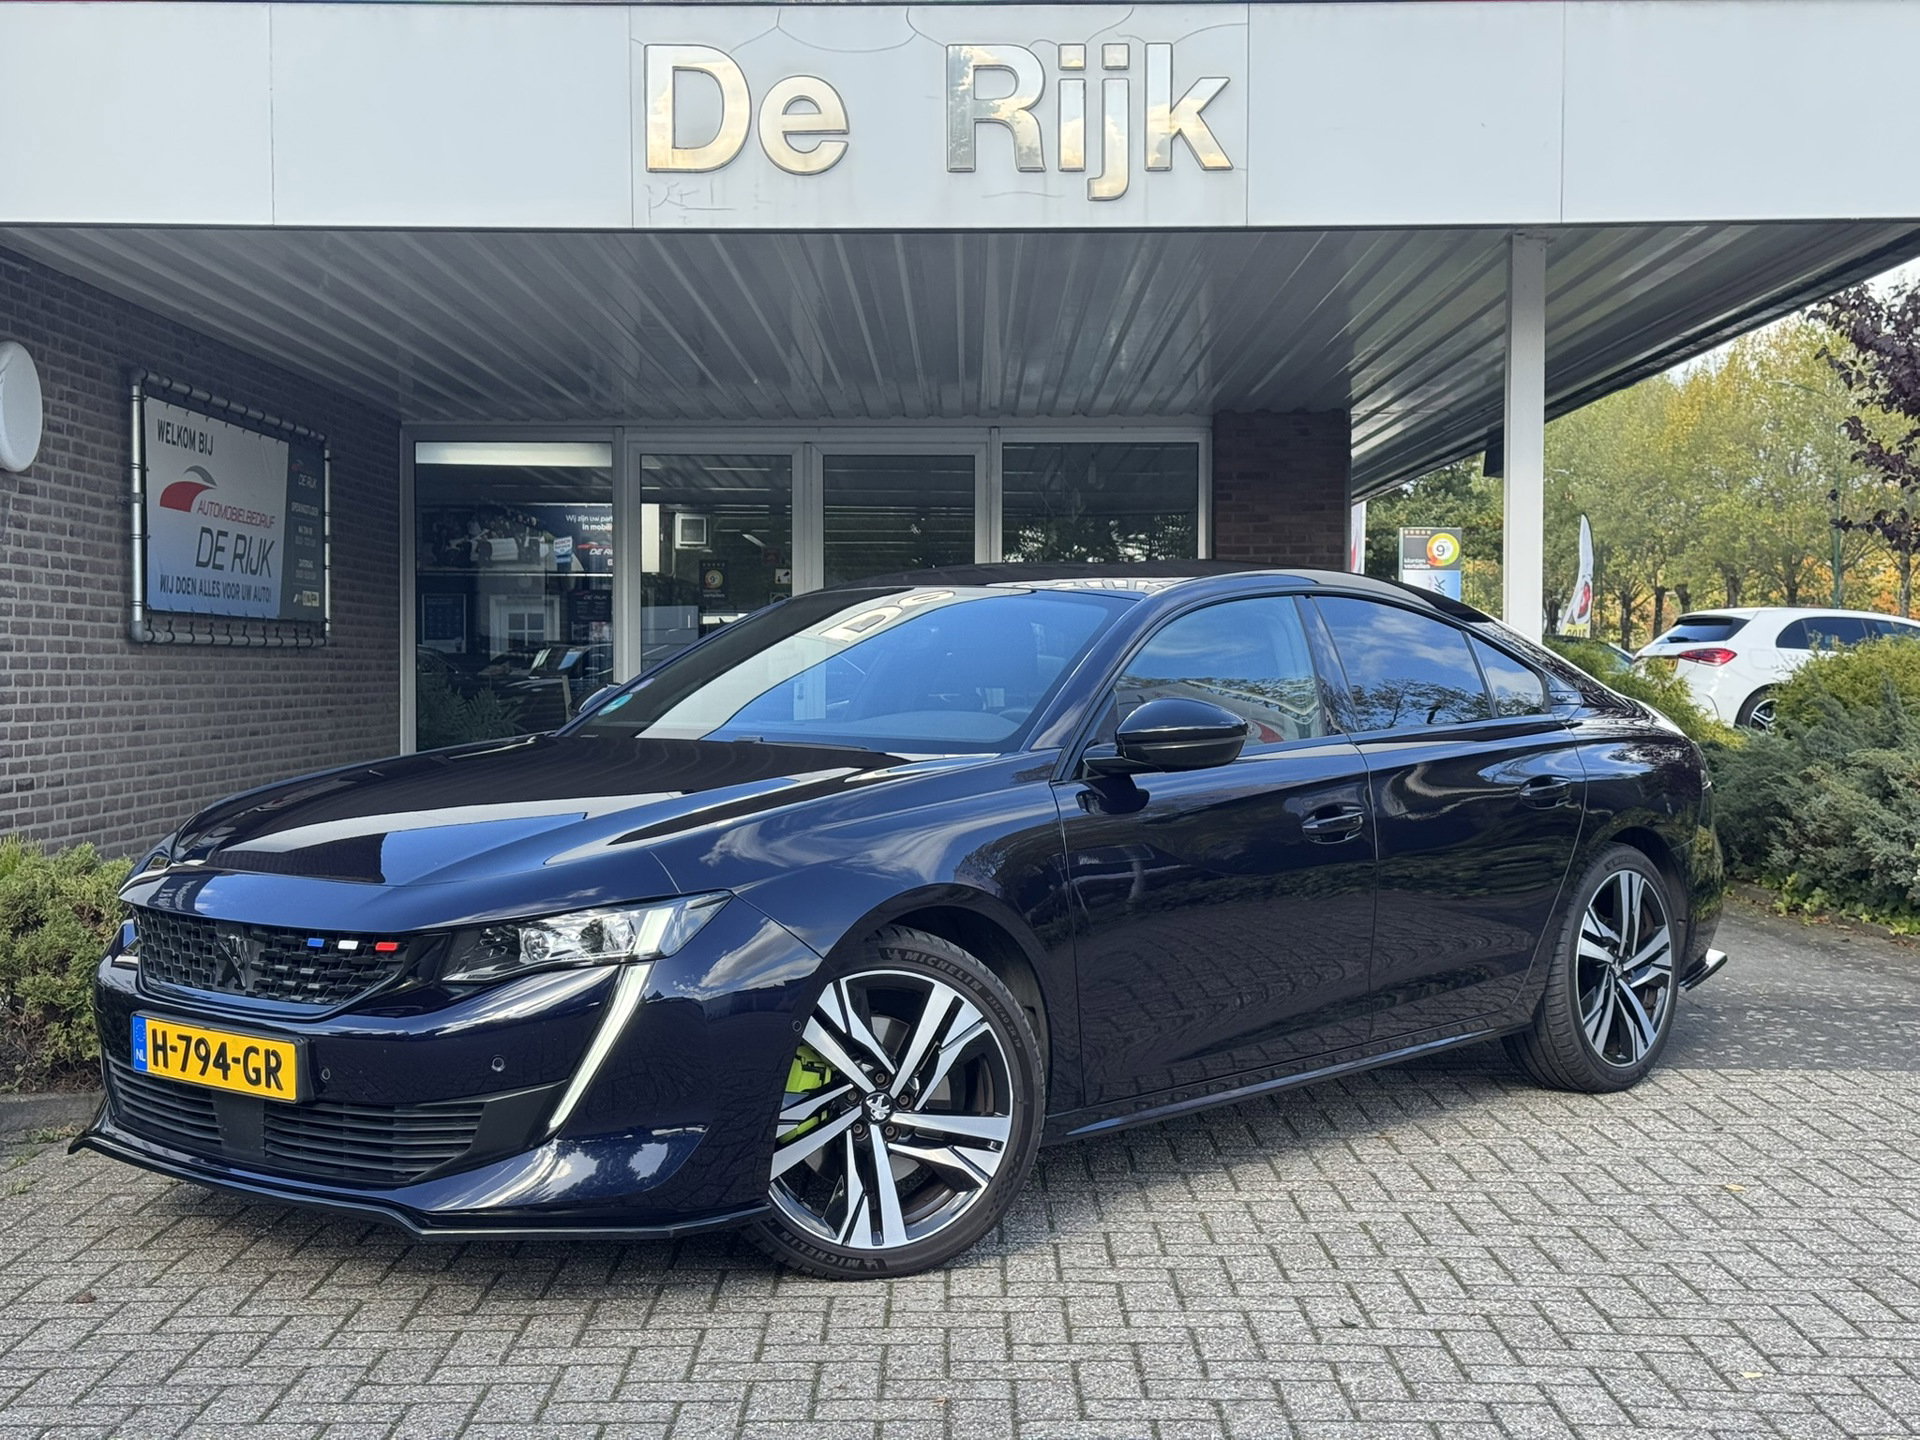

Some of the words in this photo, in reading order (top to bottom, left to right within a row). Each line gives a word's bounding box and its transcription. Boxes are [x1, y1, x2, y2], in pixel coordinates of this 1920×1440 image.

[644, 43, 850, 176] De
[945, 42, 1234, 201] Rijk
[157, 418, 196, 452] WELKOM
[198, 431, 214, 456] BIJ
[195, 526, 229, 571] DE
[230, 533, 276, 579] RIJK
[159, 574, 175, 596] WIJ
[175, 575, 197, 597] DOEN
[198, 579, 221, 599] ALLES
[221, 581, 241, 601] VOOR
[241, 583, 253, 602] UW
[903, 951, 983, 991] MICHELIN
[135, 1048, 146, 1062] NL
[151, 1028, 284, 1091] H-794-GR
[780, 1231, 862, 1270] MICHELIN
